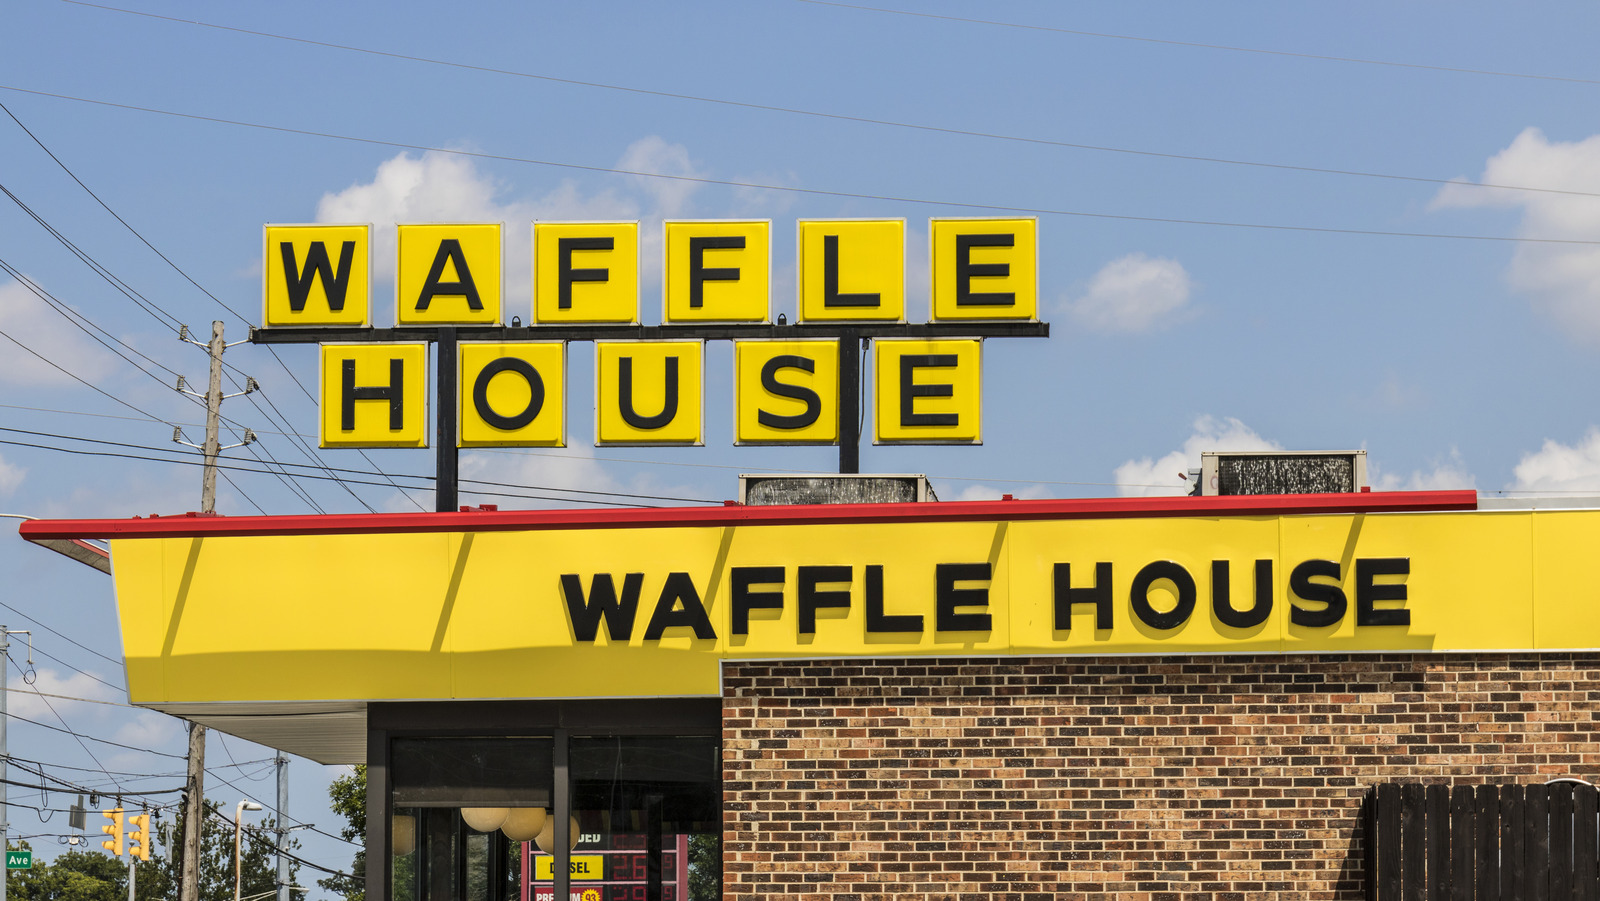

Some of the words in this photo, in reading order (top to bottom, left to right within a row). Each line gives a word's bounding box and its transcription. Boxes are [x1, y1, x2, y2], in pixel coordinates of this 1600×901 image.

[280, 234, 1016, 311] WAFFLE
[341, 354, 959, 431] HOUSE
[560, 562, 992, 642] WAFFLE
[1053, 558, 1411, 631] HOUSE
[8, 855, 28, 865] Ave
[550, 862, 590, 873] DSEL
